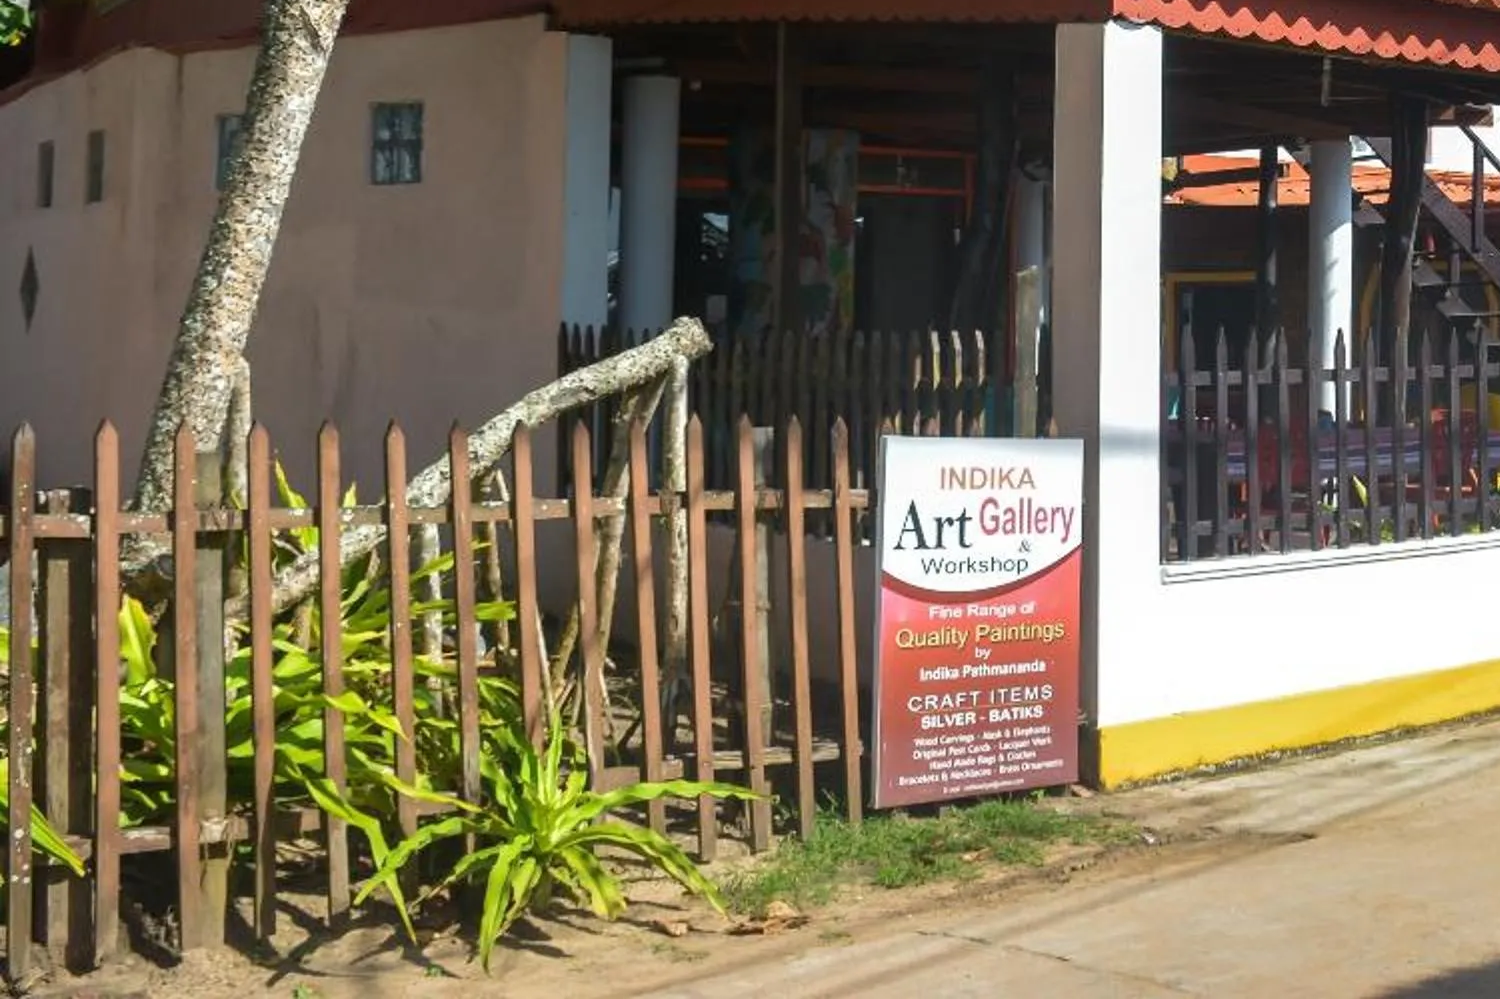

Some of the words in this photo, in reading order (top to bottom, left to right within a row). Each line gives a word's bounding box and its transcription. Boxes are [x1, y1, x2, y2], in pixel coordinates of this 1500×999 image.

[940, 466, 1036, 490] INDIKA
[893, 499, 973, 550] Art
[979, 497, 1075, 544] Gallery
[1018, 539, 1032, 553] &
[921, 556, 1029, 575] Workshop
[928, 605, 962, 620] Fine
[967, 603, 1016, 618] Range
[1020, 601, 1036, 615] of
[895, 627, 969, 648] Quality
[975, 622, 1066, 643] Paintings
[975, 647, 992, 660] by
[919, 666, 959, 682] Indika
[962, 660, 1046, 679] Pathmananda
[907, 690, 981, 712] CRAFT
[990, 684, 1053, 704] ITEMS
[921, 711, 976, 730] SILVER
[989, 705, 1044, 723] BATIKS
